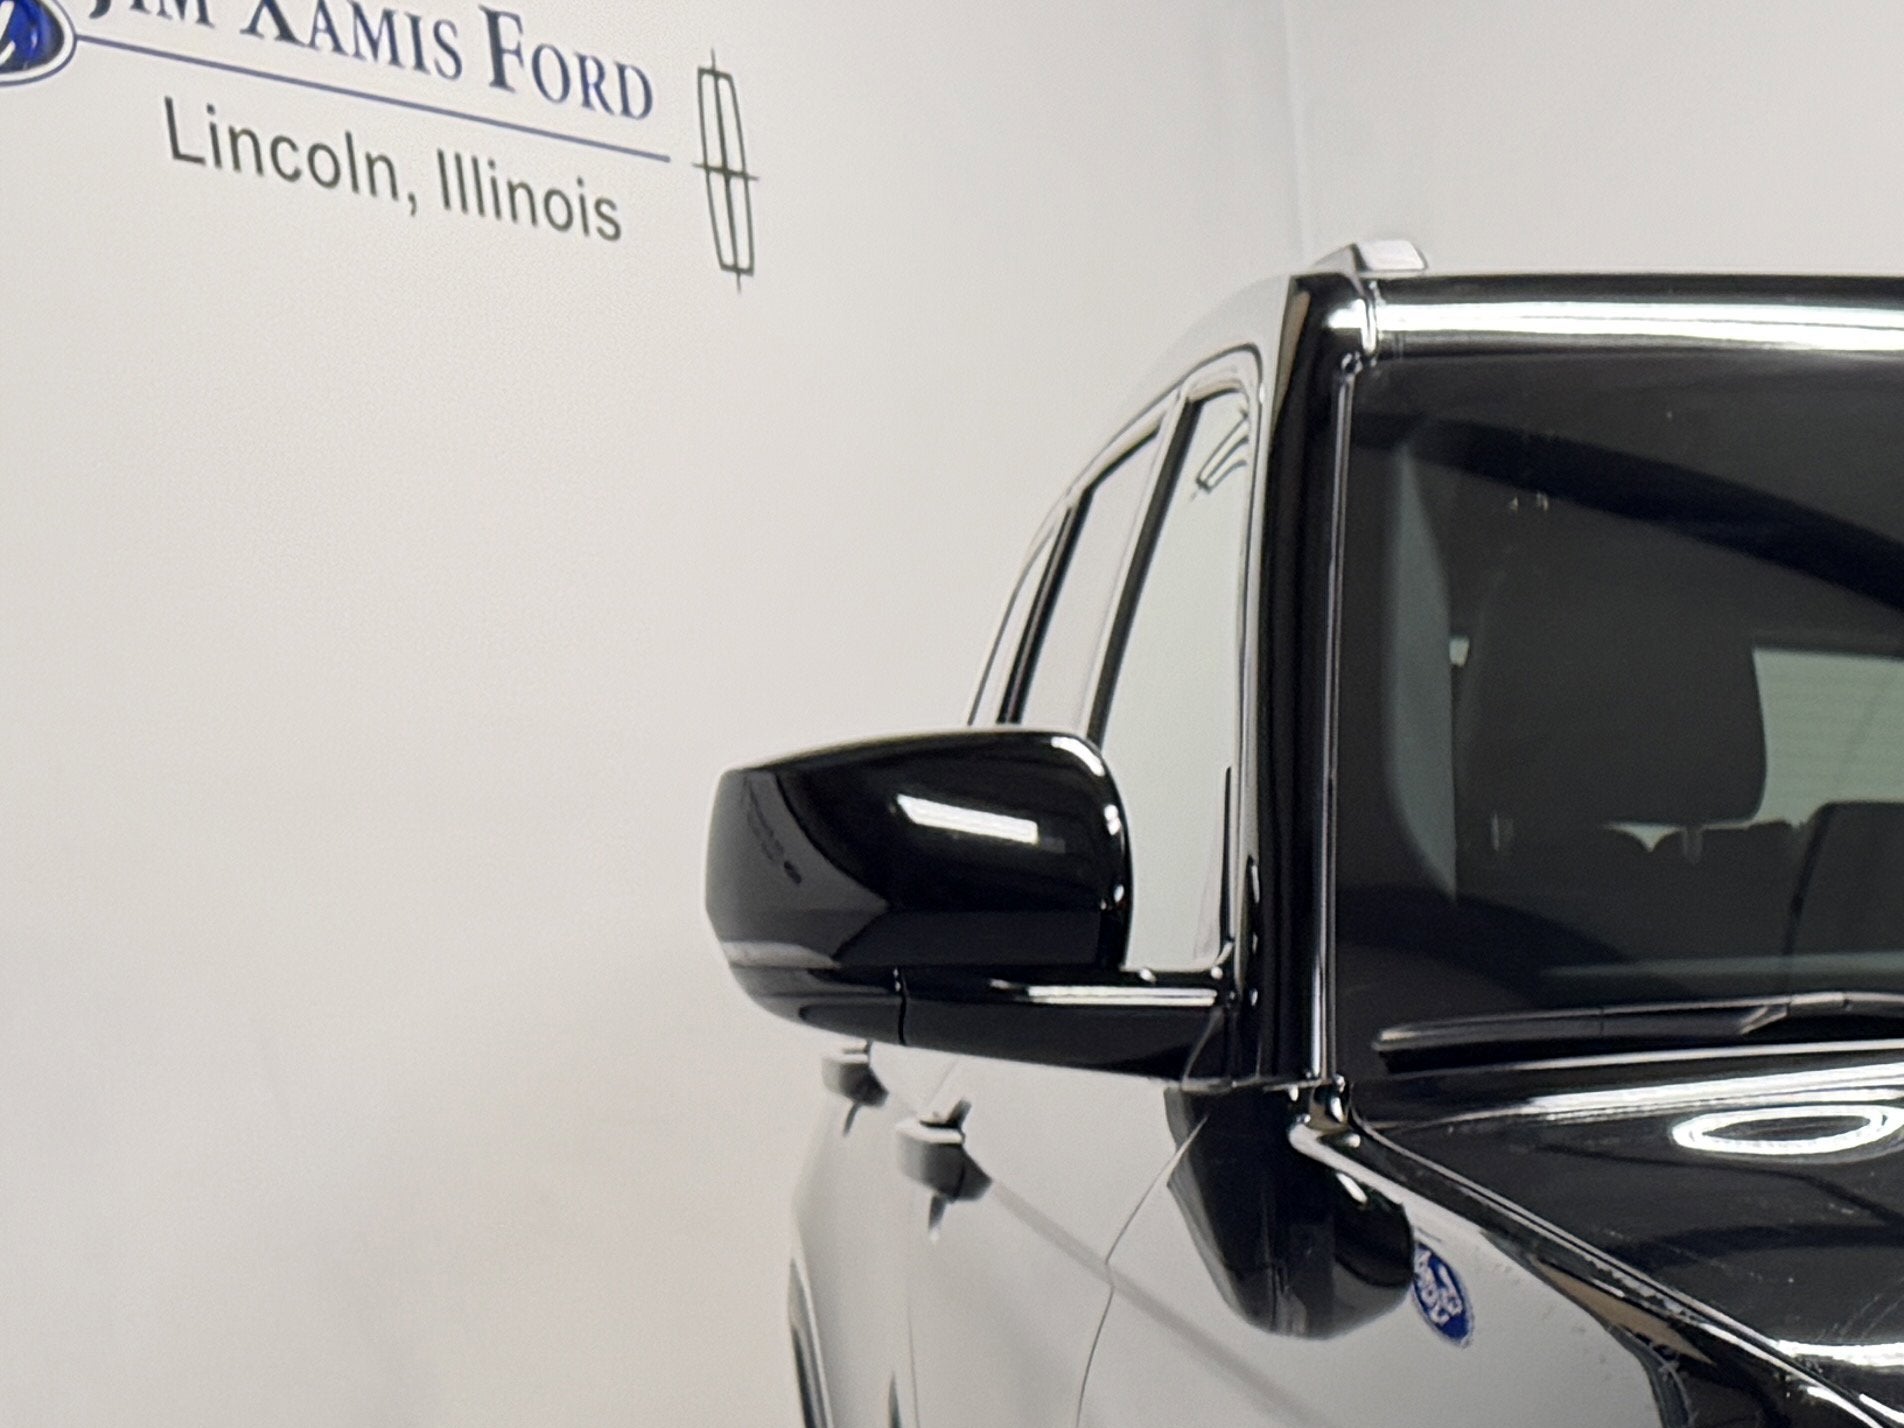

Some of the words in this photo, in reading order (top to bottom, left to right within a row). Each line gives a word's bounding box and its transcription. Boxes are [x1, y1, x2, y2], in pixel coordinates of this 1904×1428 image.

[481, 6, 653, 119] FORD
[163, 95, 418, 217] Lincoln,
[437, 149, 622, 242] Illinois
